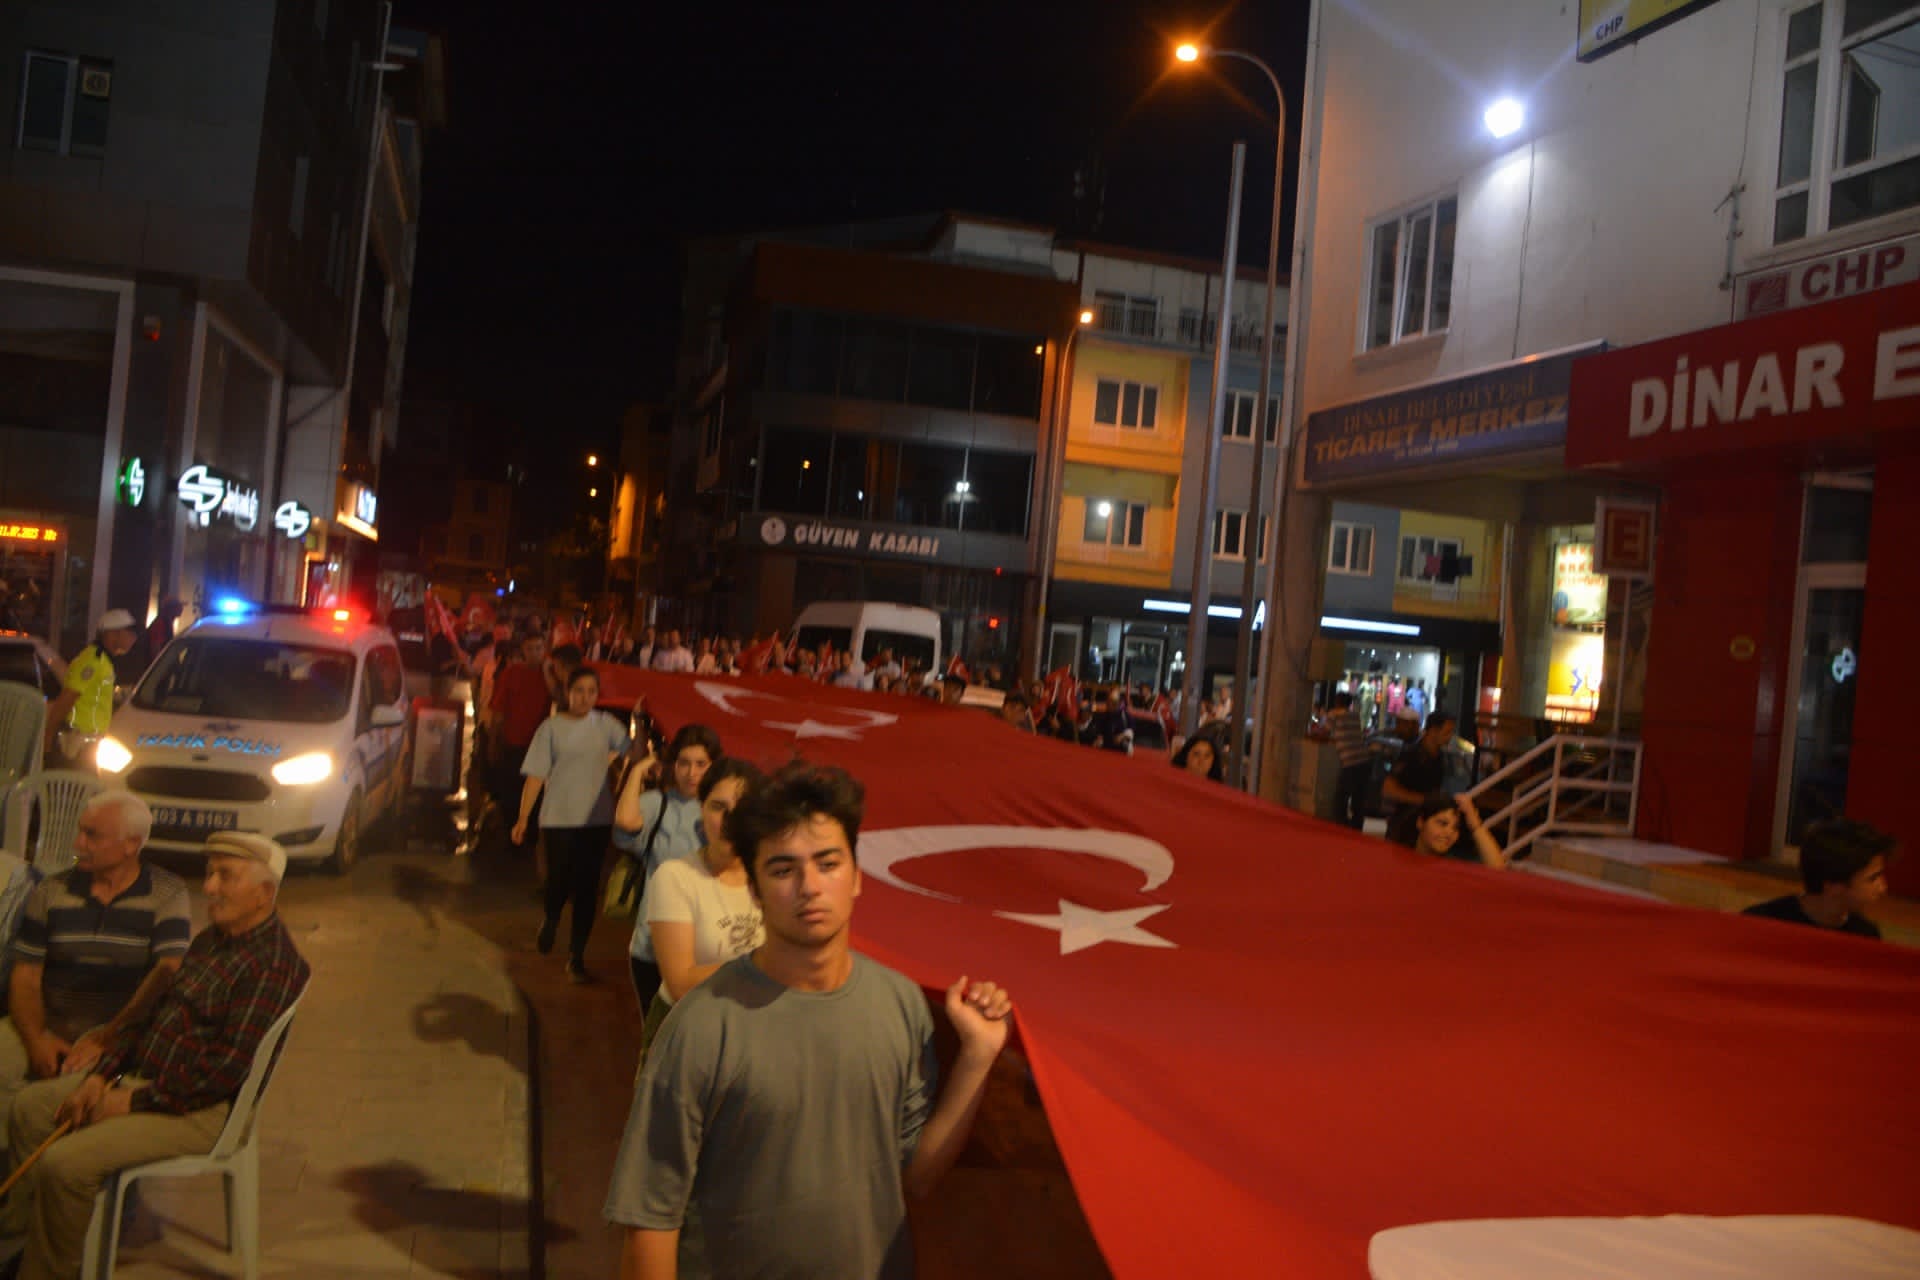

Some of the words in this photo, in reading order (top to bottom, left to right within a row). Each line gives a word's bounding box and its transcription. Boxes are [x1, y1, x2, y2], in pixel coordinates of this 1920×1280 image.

[1595, 16, 1623, 41] CHP
[1801, 246, 1905, 301] CHP
[1628, 340, 1845, 439] DİNAR
[1313, 423, 1420, 464] TİCARET
[793, 519, 860, 549] GÜVEN
[869, 530, 940, 557] KASABI
